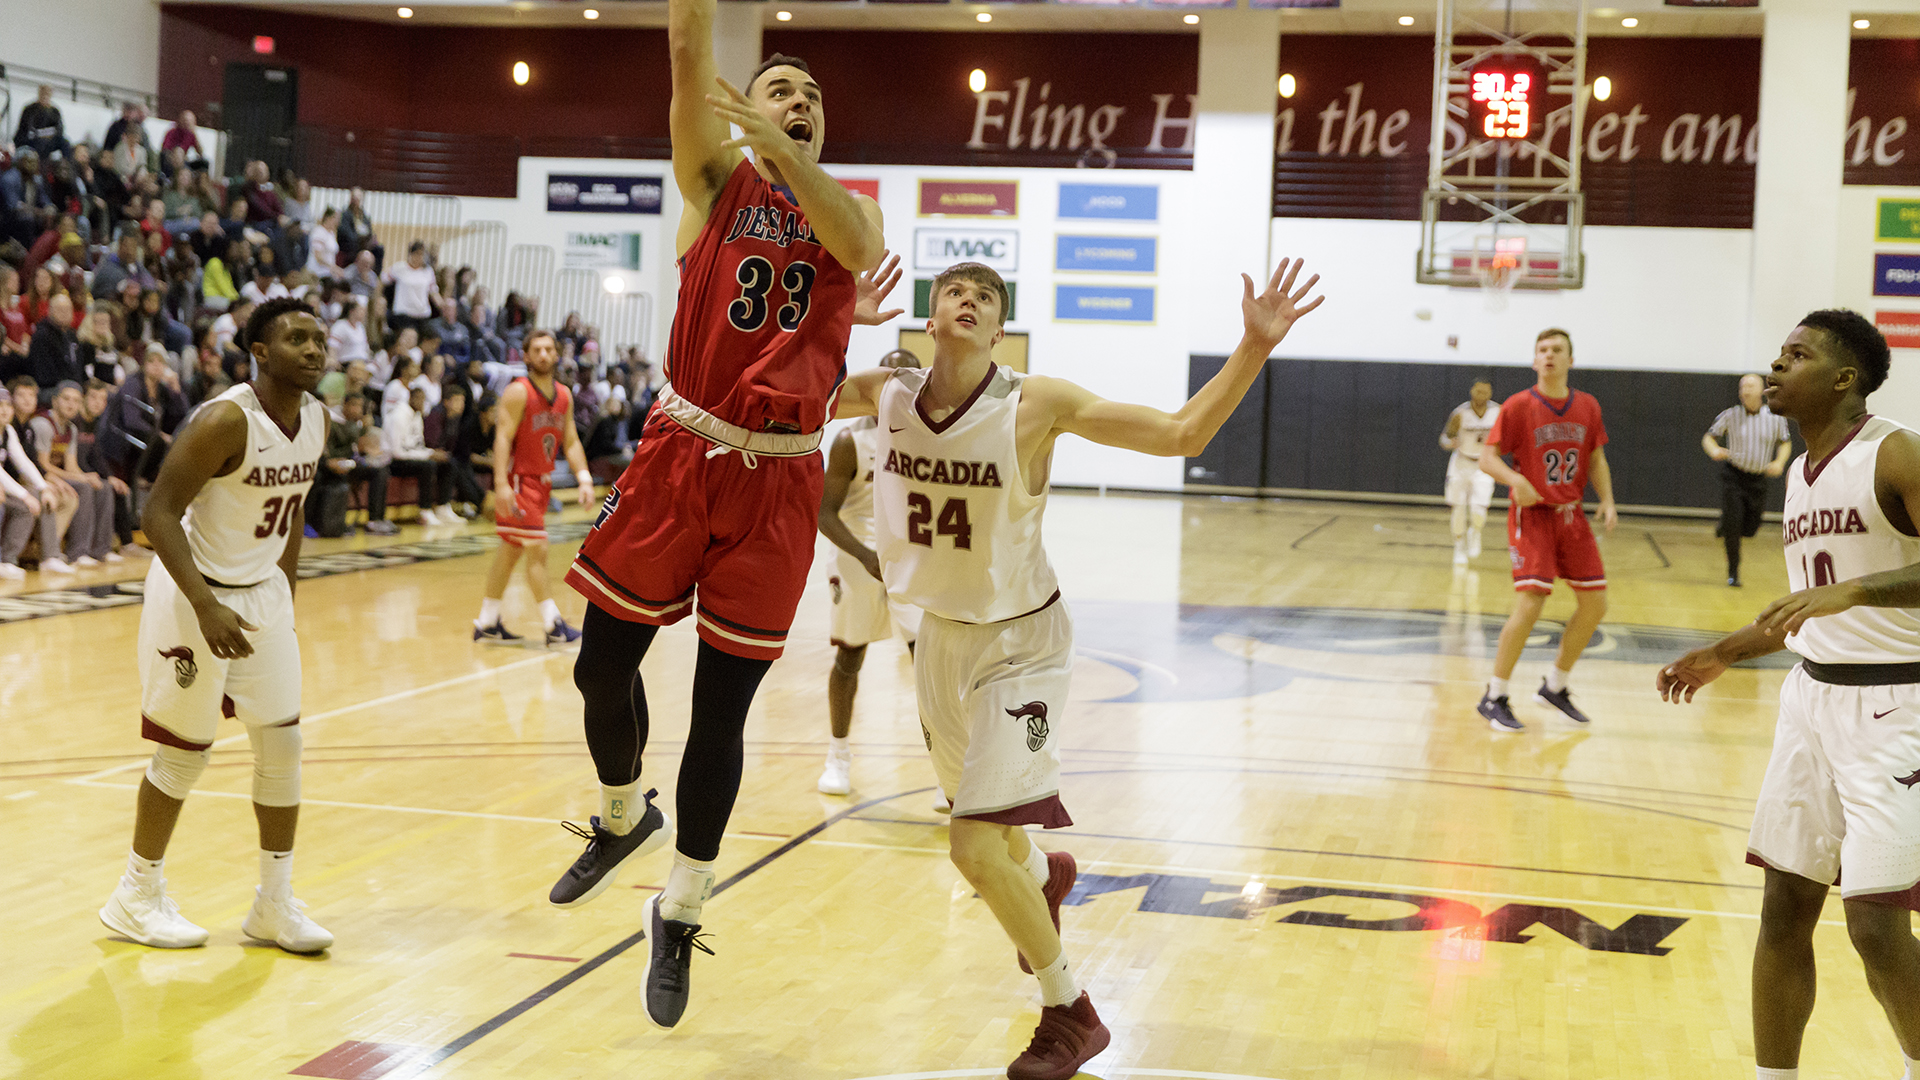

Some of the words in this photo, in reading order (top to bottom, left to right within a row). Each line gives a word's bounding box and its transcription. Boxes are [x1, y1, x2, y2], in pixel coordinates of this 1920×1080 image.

[1472, 72, 1531, 101] 30.2
[966, 77, 1125, 168] Fling
[1317, 81, 1410, 157] the
[1430, 83, 1649, 163] Sret
[1843, 86, 1908, 167] he
[1483, 100, 1530, 138] 23
[724, 205, 823, 247] DESAL
[944, 238, 1006, 258] MAC
[727, 255, 817, 332] 33
[242, 461, 317, 487] ARCADI
[883, 447, 1004, 489] ARCADIA
[1542, 447, 1580, 486] 22
[253, 493, 303, 539] 30
[907, 489, 972, 552] 24
[1783, 506, 1870, 549] ARCADIA
